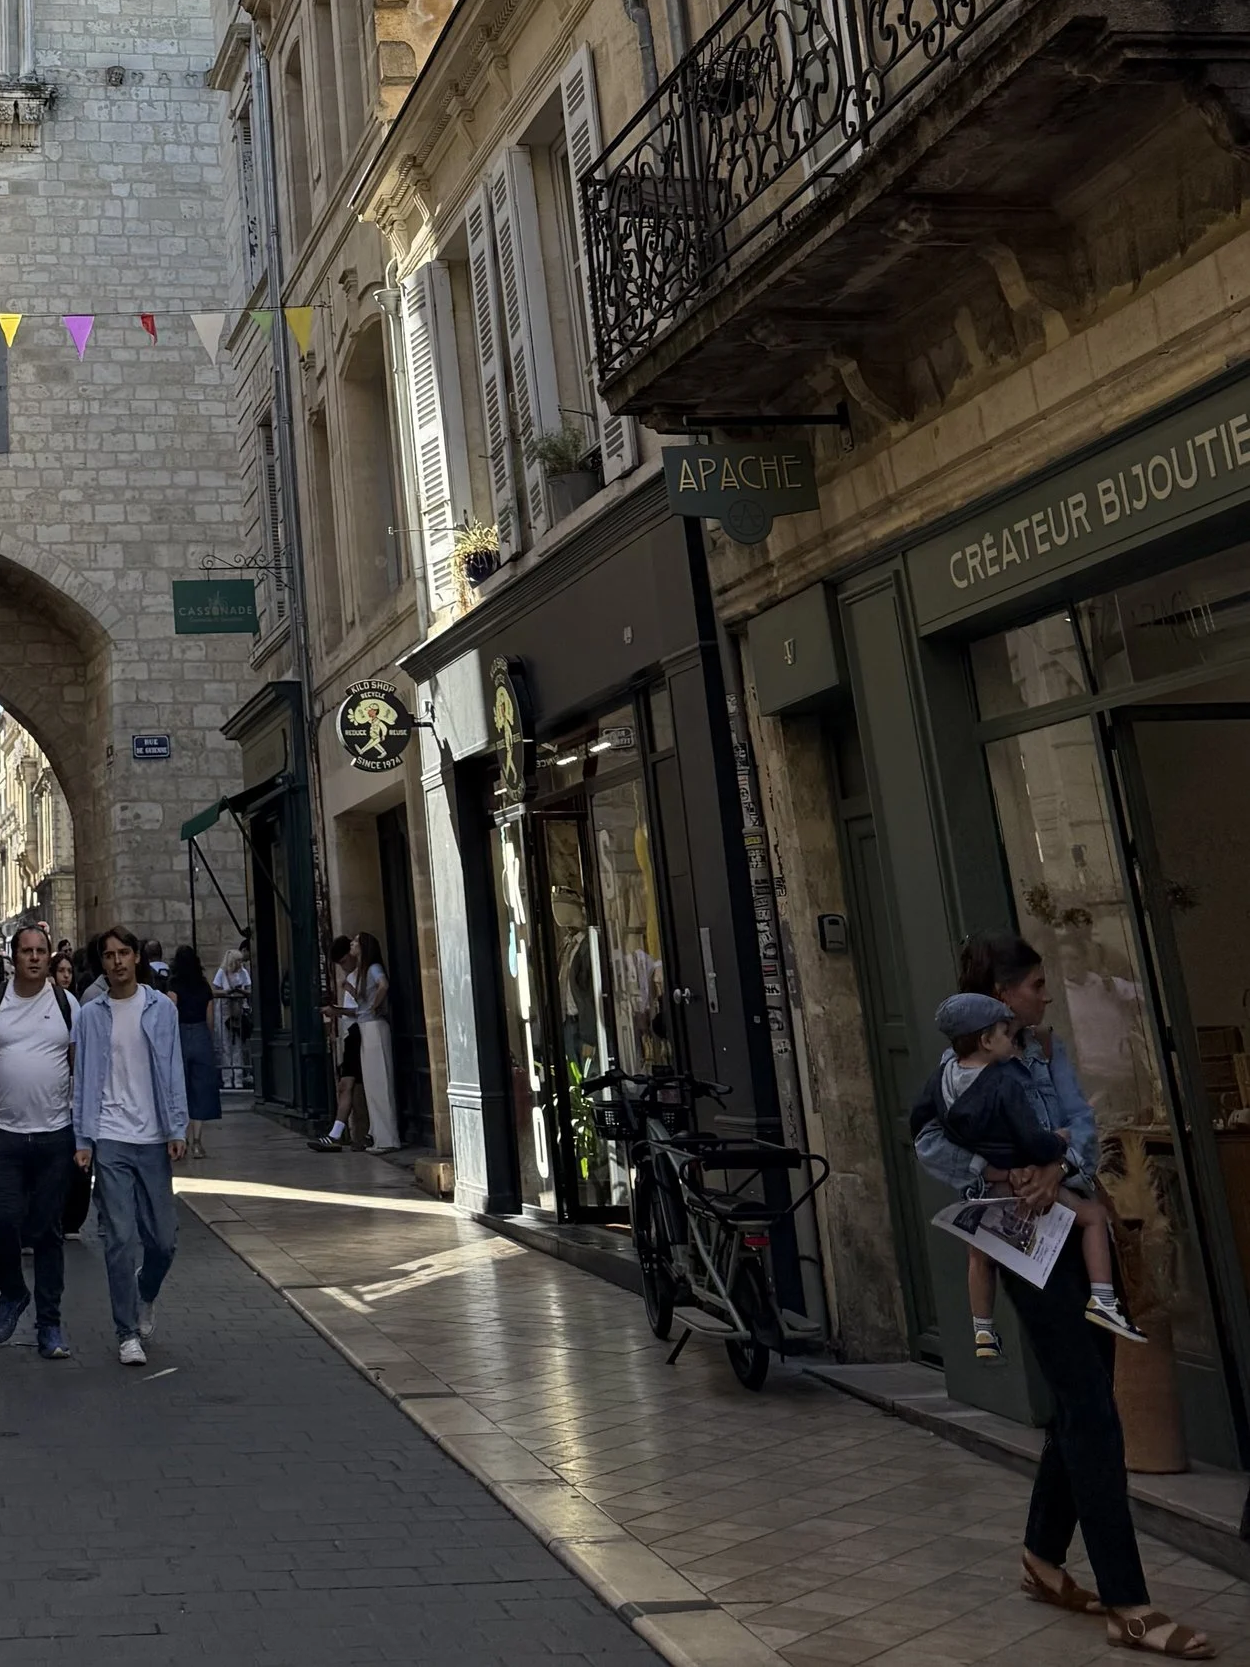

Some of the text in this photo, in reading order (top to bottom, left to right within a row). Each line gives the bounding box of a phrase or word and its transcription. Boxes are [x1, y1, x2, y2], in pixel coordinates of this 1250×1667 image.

[679, 455, 802, 493] APACHE
[950, 413, 1250, 589] CRÉATEUR BIJOUTIE
[178, 605, 254, 616] CASSONADE
[351, 681, 396, 694] KILO SHOP
[360, 691, 386, 700] RECYCLE
[356, 755, 402, 770] SINCE 1974
